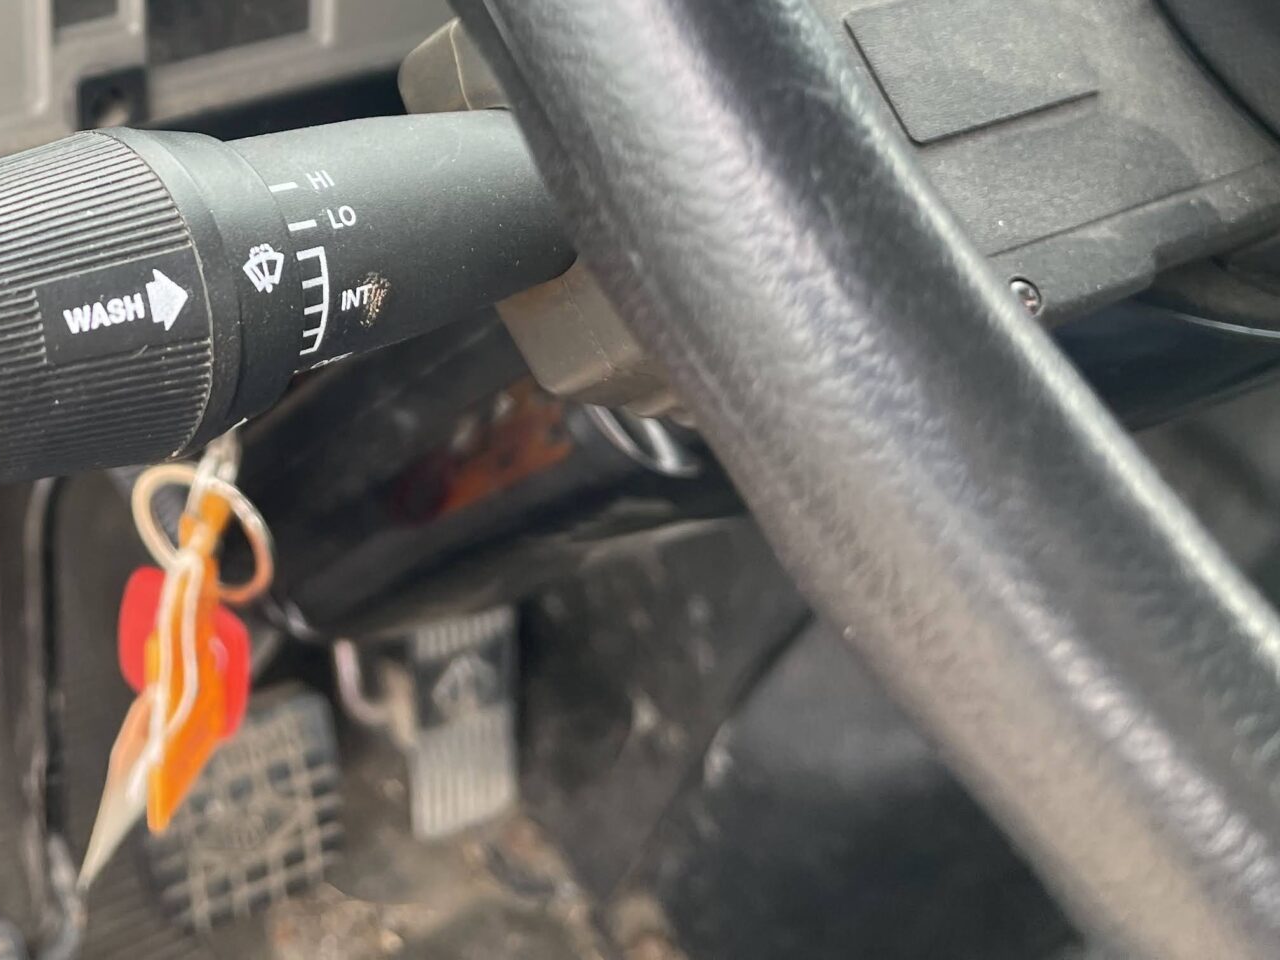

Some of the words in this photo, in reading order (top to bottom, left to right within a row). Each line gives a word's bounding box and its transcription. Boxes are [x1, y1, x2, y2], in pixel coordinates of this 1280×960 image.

[305, 169, 335, 191] HI
[326, 205, 357, 230] LO
[62, 292, 145, 335] WASH
